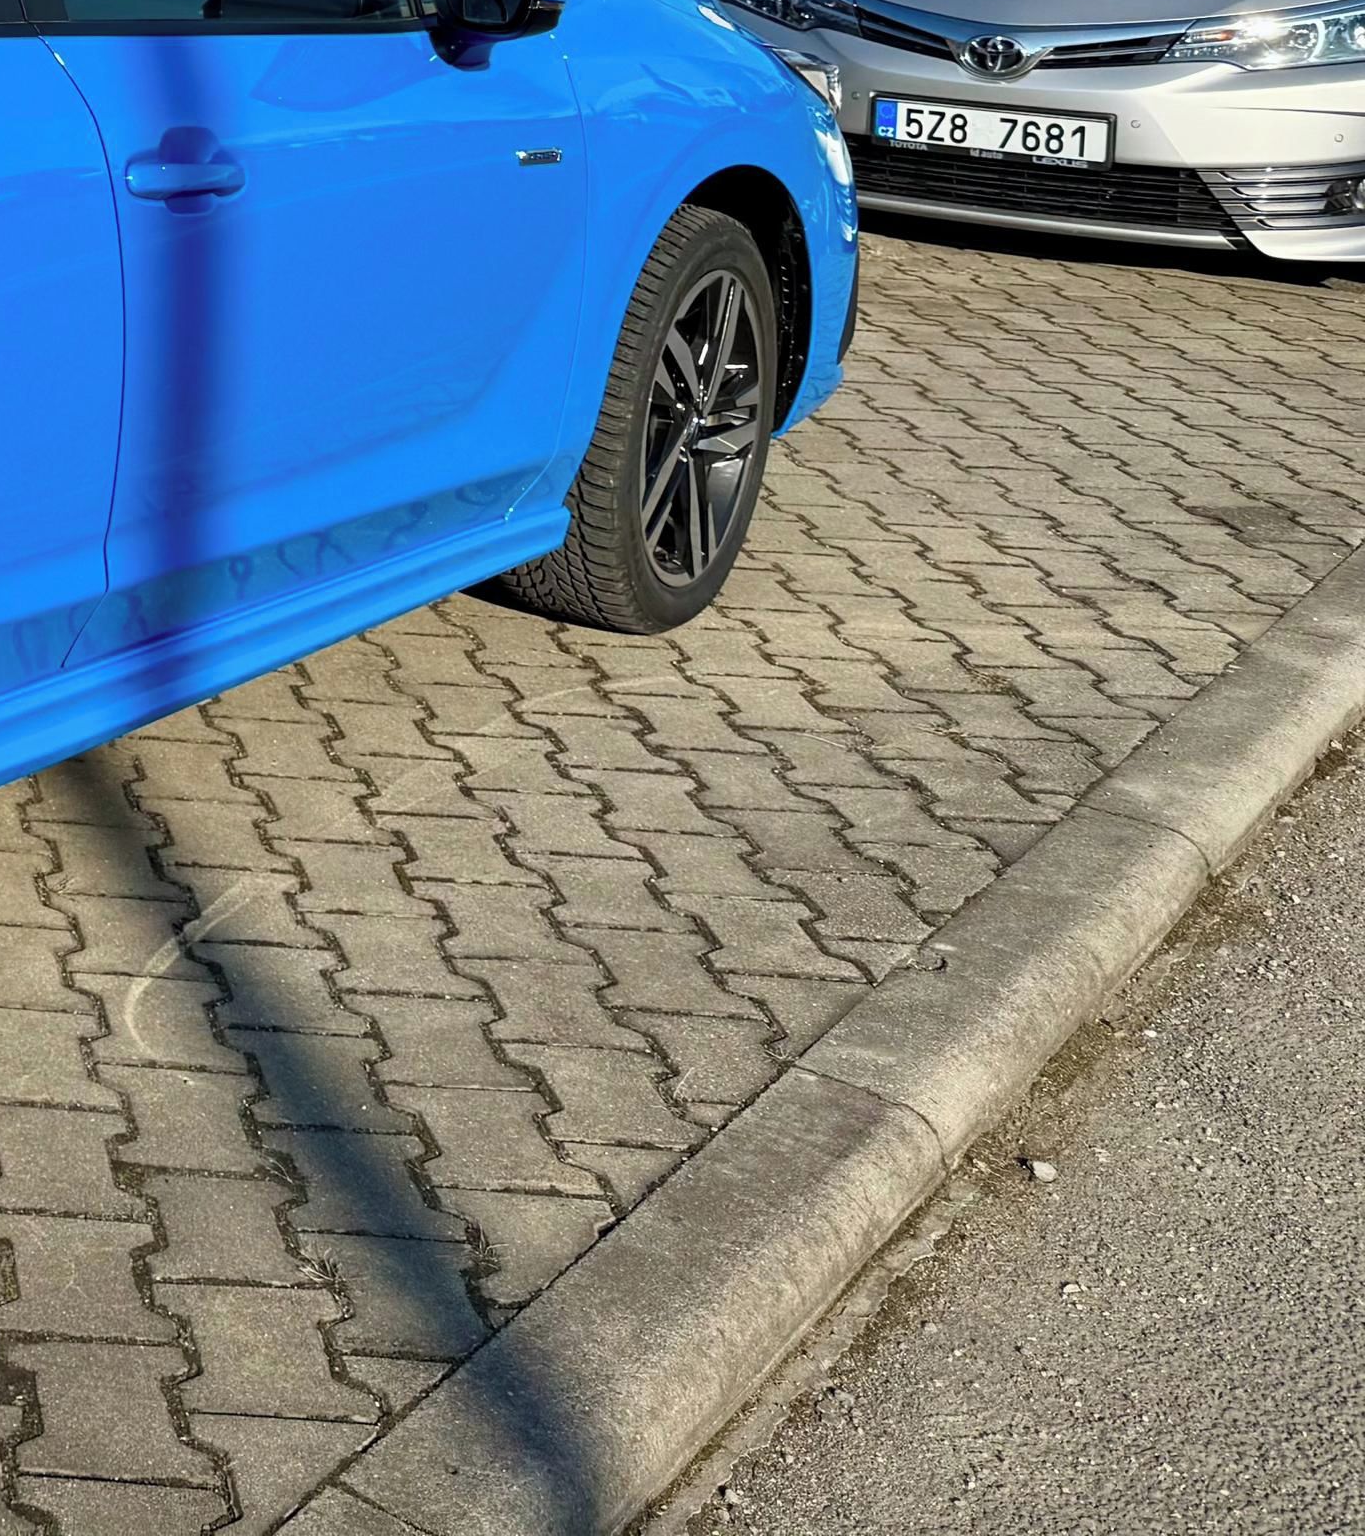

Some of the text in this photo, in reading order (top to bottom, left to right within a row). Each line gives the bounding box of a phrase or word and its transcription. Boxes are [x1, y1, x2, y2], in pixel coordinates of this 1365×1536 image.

[878, 126, 895, 138] CZ
[905, 107, 1087, 158] 5Z8 7681
[889, 139, 929, 152] TOYOTA
[981, 150, 1004, 161] auto
[1032, 155, 1088, 169] LEXUS
